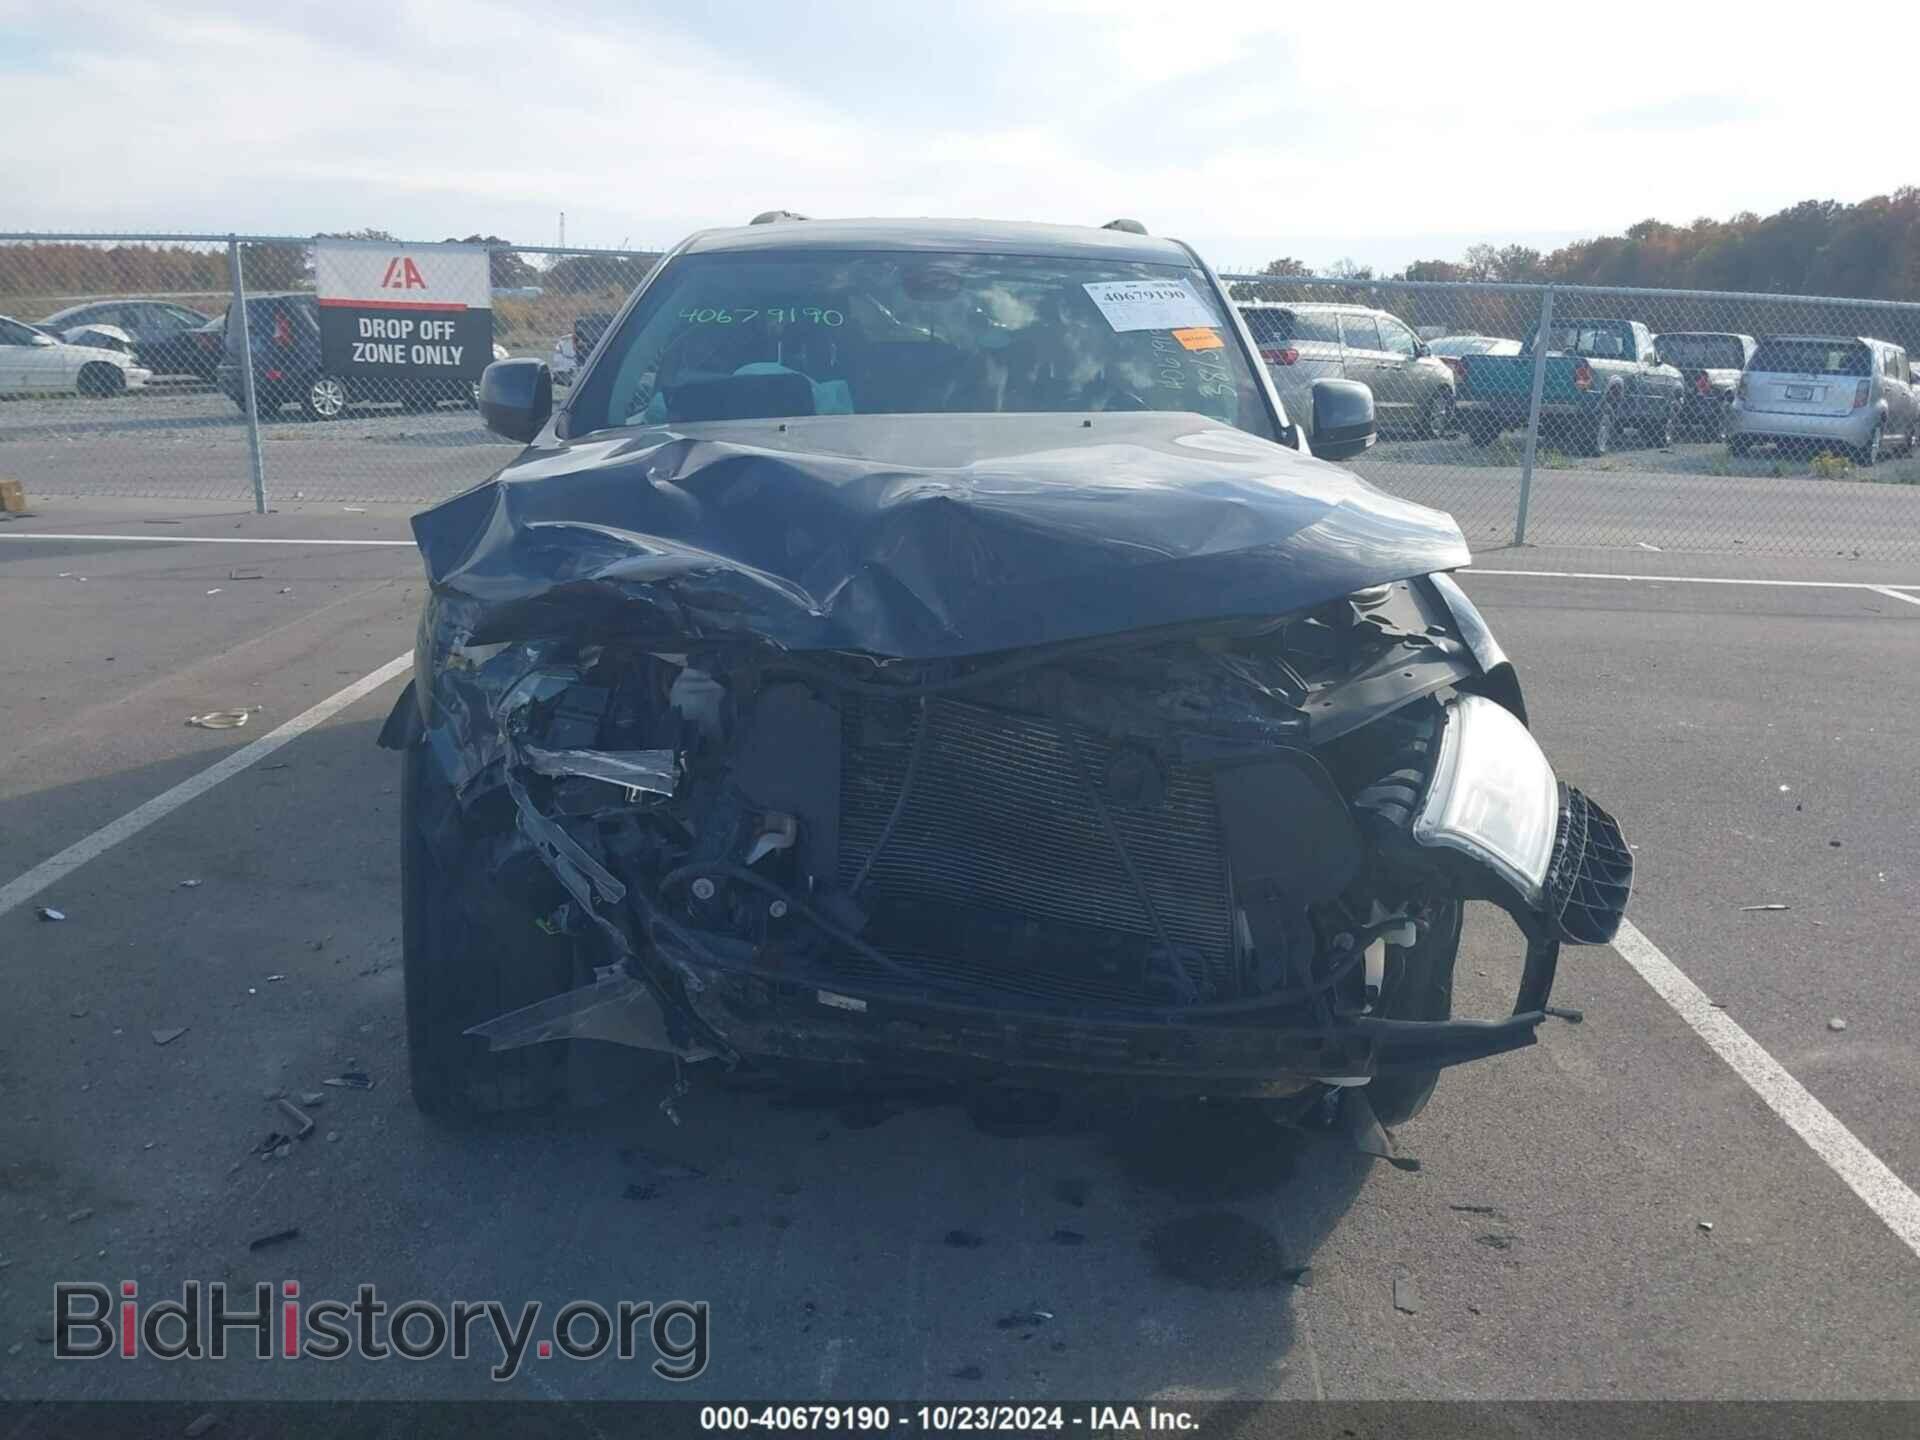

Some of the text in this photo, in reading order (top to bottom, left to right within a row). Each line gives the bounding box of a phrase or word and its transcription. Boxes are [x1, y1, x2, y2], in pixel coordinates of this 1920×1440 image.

[1104, 289, 1186, 302] 40679190
[359, 318, 455, 340] DROP OFF
[352, 342, 463, 365] ZONE ONLY
